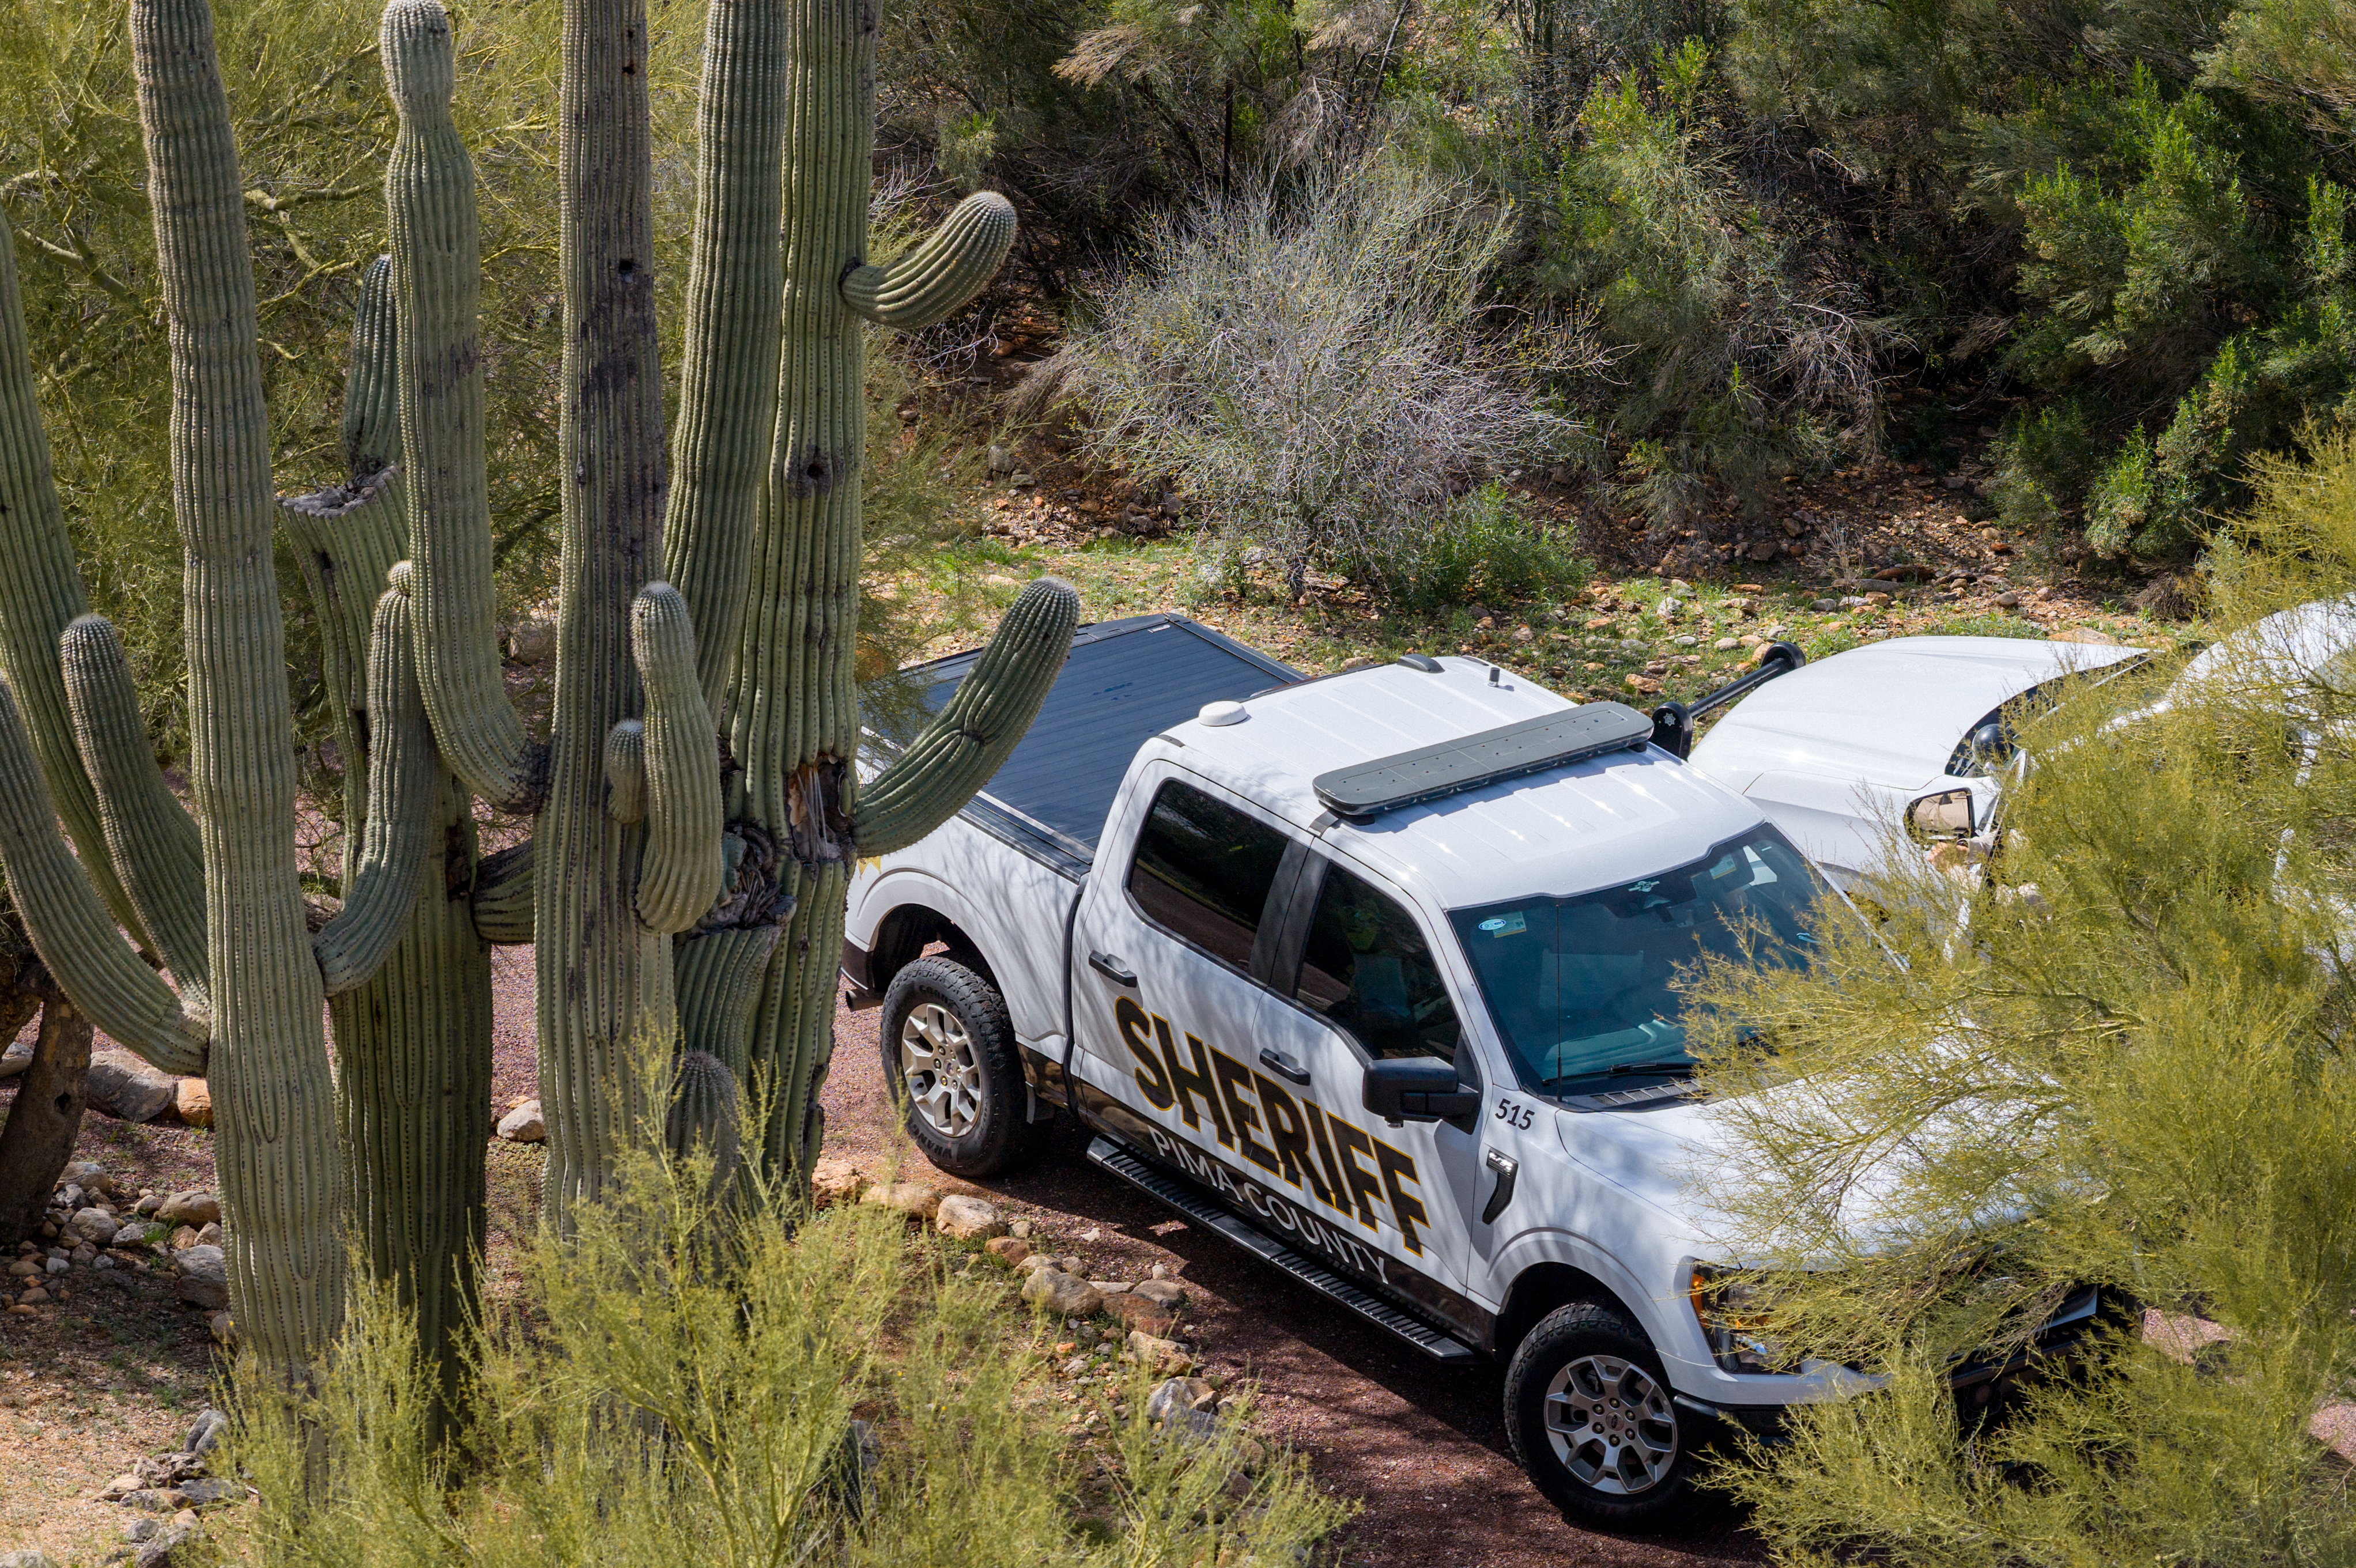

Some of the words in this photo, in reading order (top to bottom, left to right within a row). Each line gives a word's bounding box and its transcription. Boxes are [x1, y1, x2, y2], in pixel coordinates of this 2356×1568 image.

[1115, 996, 1431, 1258] SHERIFF
[1495, 1098, 1535, 1130] 515
[1147, 1125, 1243, 1201] PIMA
[1244, 1182, 1389, 1284] COUNTY
